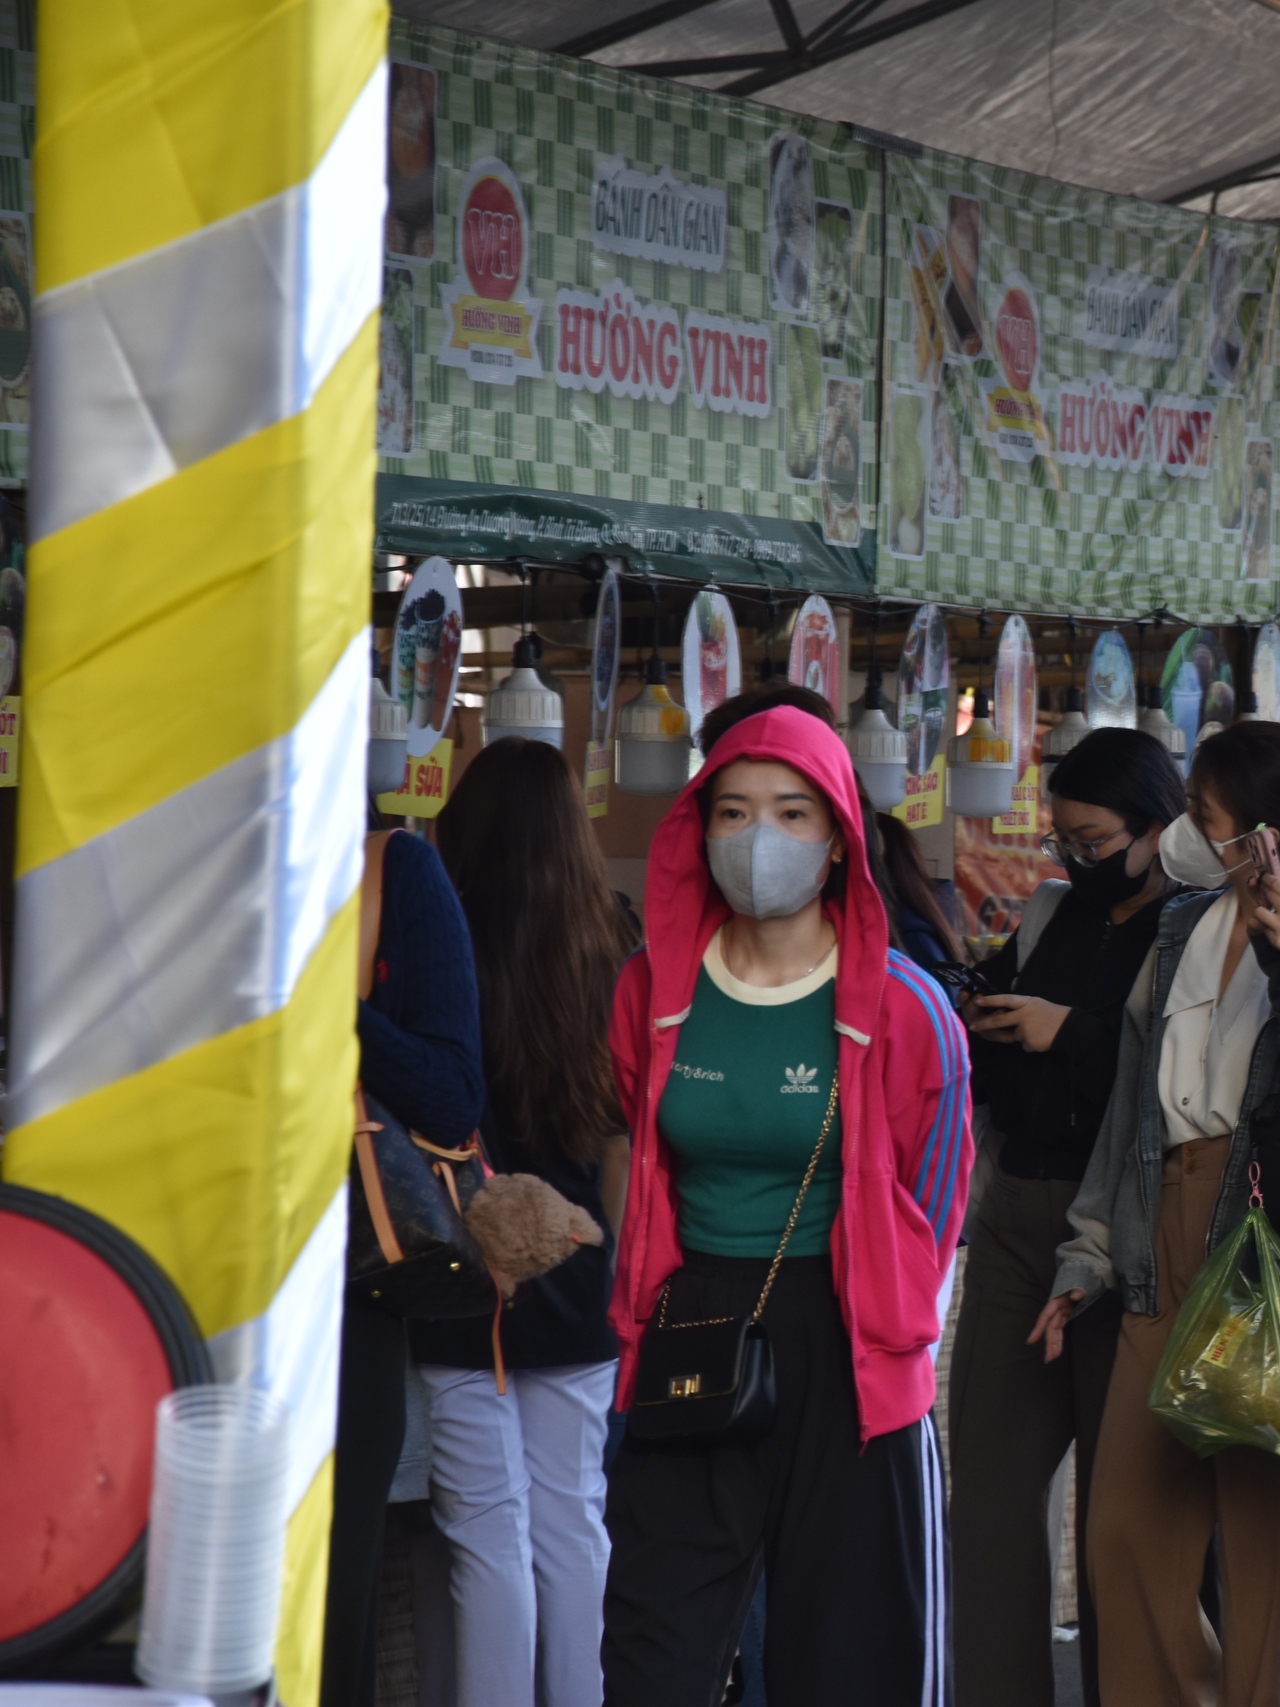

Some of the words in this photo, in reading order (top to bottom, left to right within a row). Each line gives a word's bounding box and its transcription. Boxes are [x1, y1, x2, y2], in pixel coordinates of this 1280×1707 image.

[467, 208, 517, 281] VH
[683, 199, 725, 255] GIAN
[558, 292, 679, 391] HƯỜNG
[688, 326, 768, 405] VINH
[1059, 383, 1146, 461] HƯỜNG
[1151, 405, 1213, 467] VINH
[780, 1083, 820, 1094] adidas
